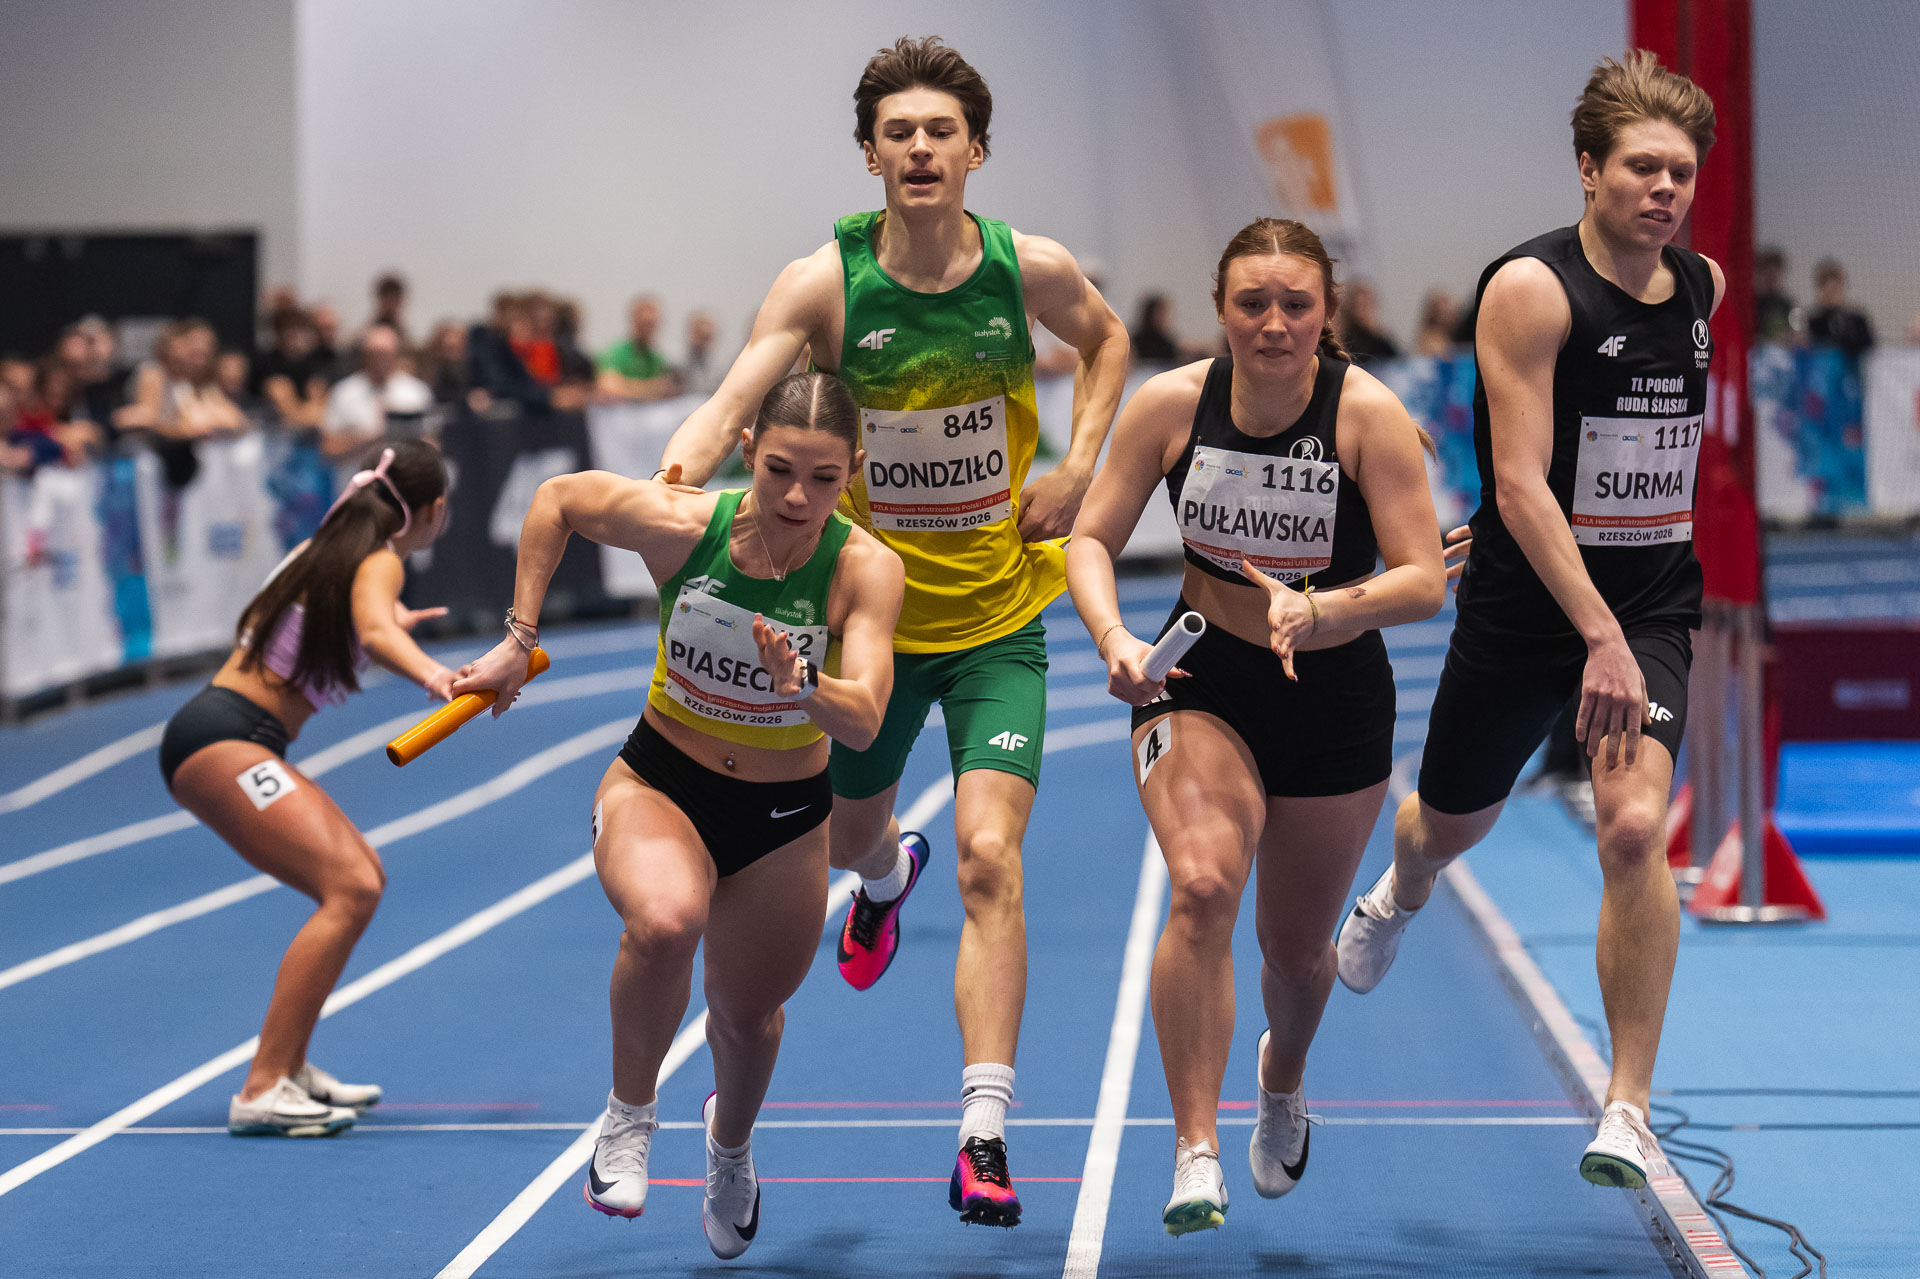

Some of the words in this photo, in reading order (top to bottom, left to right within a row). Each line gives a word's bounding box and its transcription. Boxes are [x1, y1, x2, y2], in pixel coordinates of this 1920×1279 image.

[857, 328, 897, 350] 4F
[974, 329, 1001, 338] Białystok
[1597, 336, 1627, 357] 4F
[1631, 377, 1643, 392] TL
[1646, 375, 1684, 393] POGOŃ
[1616, 396, 1649, 413] RUDA
[1651, 396, 1688, 416] ŚLĄSKA
[943, 406, 993, 438] 845
[1654, 420, 1700, 450] 1117
[870, 449, 1003, 488] DONDZIŁO
[1262, 463, 1335, 494] 1116
[1594, 469, 1683, 499] SURMA
[961, 502, 982, 511] Polski
[897, 516, 958, 528] RZESZÓW
[961, 511, 991, 527] 2026
[1184, 499, 1329, 543] PUŁAWSKA
[1598, 530, 1653, 541] RZESZÓW
[1653, 528, 1673, 540] 2026
[1271, 559, 1294, 567] Polski
[686, 574, 727, 594] 4F
[1269, 571, 1302, 582] 2026
[775, 607, 803, 618] Białystok
[670, 639, 775, 693] PIASEC
[684, 695, 747, 722] RZESZÓW
[748, 715, 783, 724] 2026
[988, 730, 1029, 751] 4F
[1145, 728, 1163, 770] 4
[252, 767, 281, 797] 5
